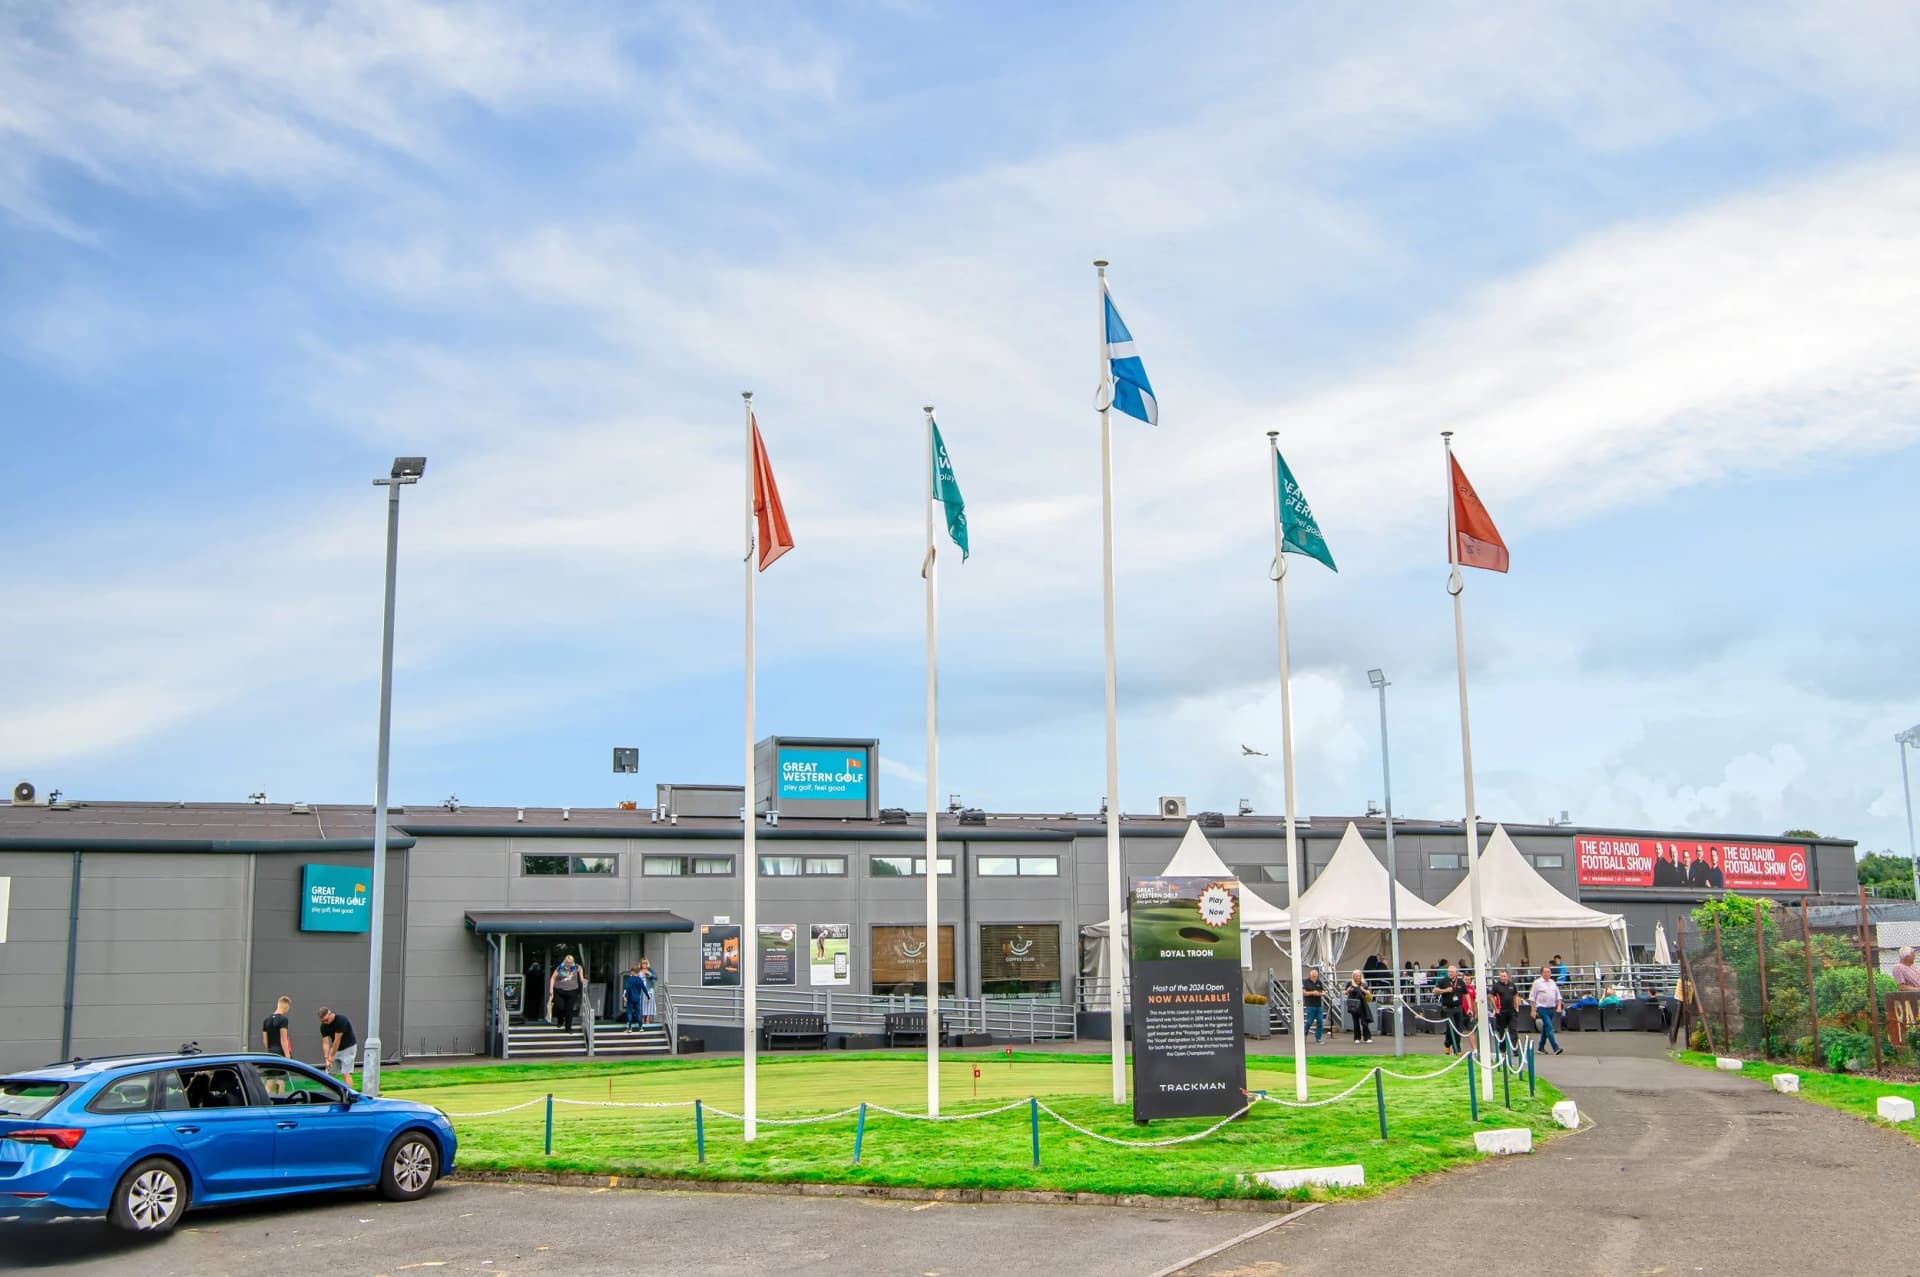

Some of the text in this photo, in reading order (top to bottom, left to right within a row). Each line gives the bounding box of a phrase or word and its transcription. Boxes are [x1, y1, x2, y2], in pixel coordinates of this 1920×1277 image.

[783, 762, 818, 772] GREAT
[783, 772, 864, 783] WESTERN GOLF
[1580, 840, 1639, 856] THE GO RADIO
[1723, 846, 1775, 861] THE GO RADIO
[1581, 855, 1652, 871] FOOTBALL SHOW
[1724, 860, 1786, 875] FOOTBALL SHOW
[1791, 859, 1803, 872] Go
[311, 886, 336, 895] GREAT
[311, 895, 367, 906] WESTERN GOLF
[1160, 949, 1213, 958] ROYAL TROON
[1169, 984, 1177, 992] of
[1177, 984, 1188, 992] the
[1205, 983, 1224, 991] Open
[1148, 992, 1230, 1004] NOW AVAILABLE!
[1160, 1082, 1226, 1092] TRACKMAN
